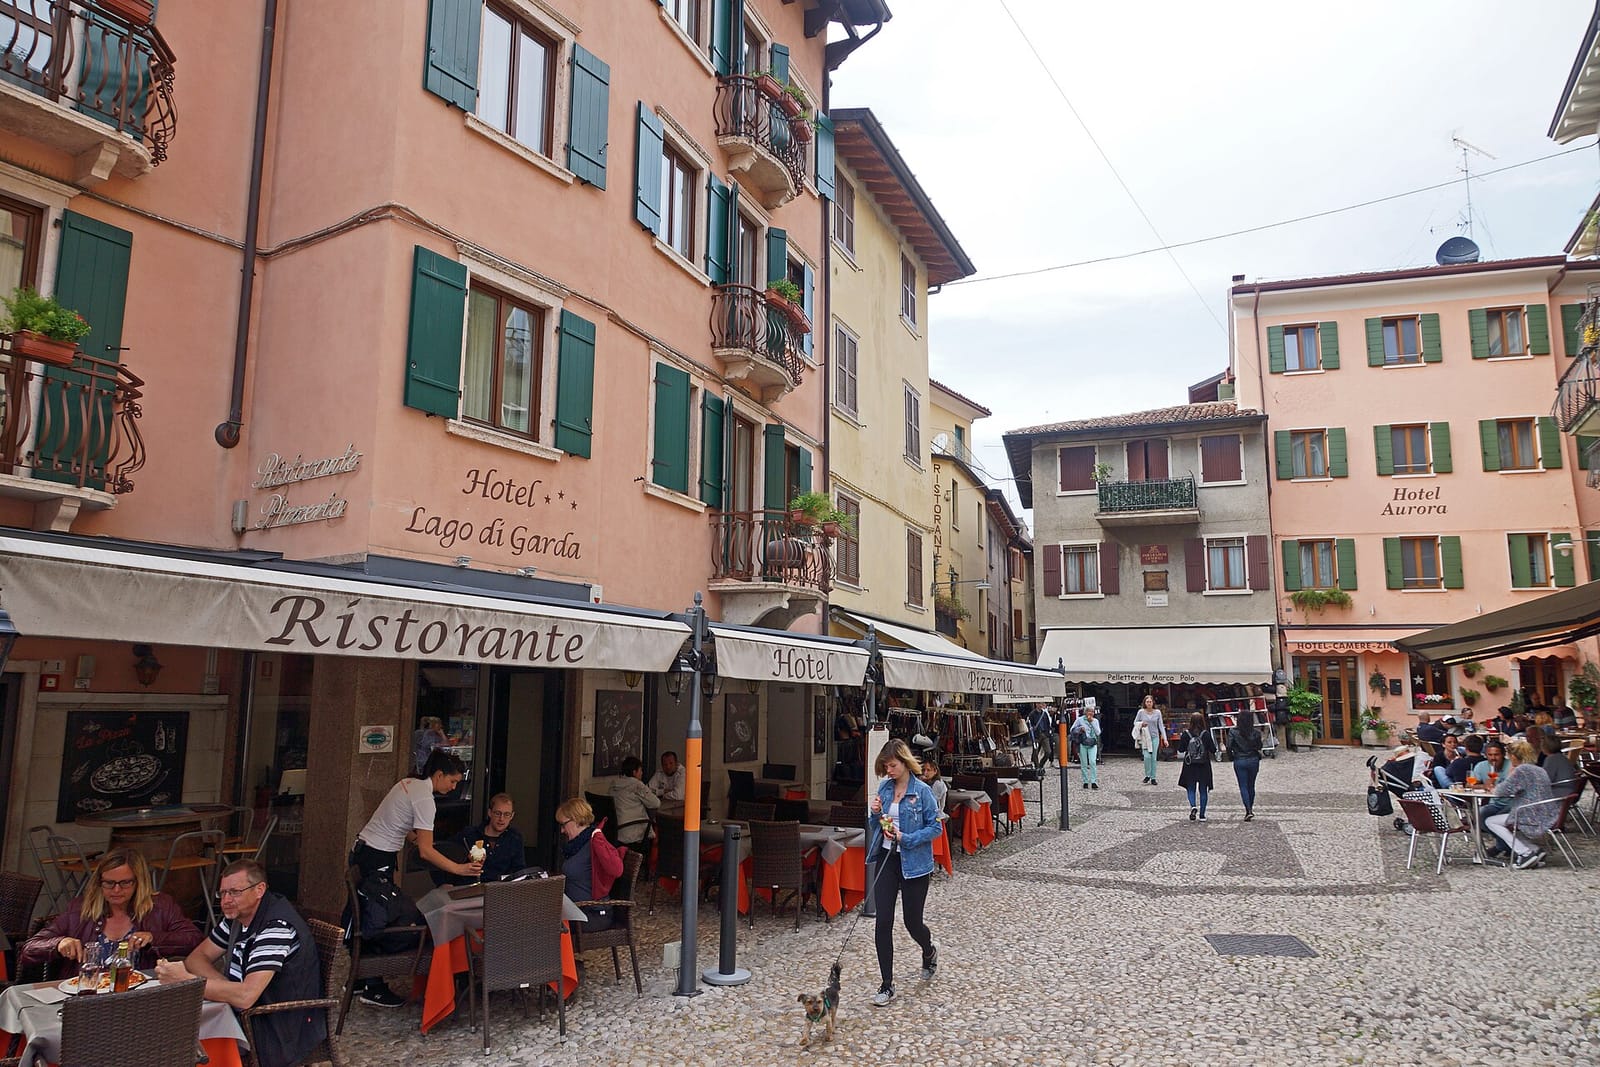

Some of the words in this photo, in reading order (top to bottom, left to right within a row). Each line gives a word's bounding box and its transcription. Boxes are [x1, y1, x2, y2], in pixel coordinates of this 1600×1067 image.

[252, 443, 363, 488] Ristorante
[462, 469, 542, 508] Hotel
[1392, 486, 1441, 500] Hotel
[256, 494, 348, 529] Pizzeria
[1380, 502, 1447, 515] Aurora
[405, 506, 473, 549] Lago
[479, 518, 505, 547] di
[510, 526, 581, 560] Garda
[264, 595, 585, 664] Ristorante
[772, 648, 834, 680] Hotel
[1107, 673, 1145, 681] Pelletterie
[1151, 674, 1175, 682] Marco
[1180, 674, 1195, 682] Polo
[968, 671, 1014, 693] Pizzeria
